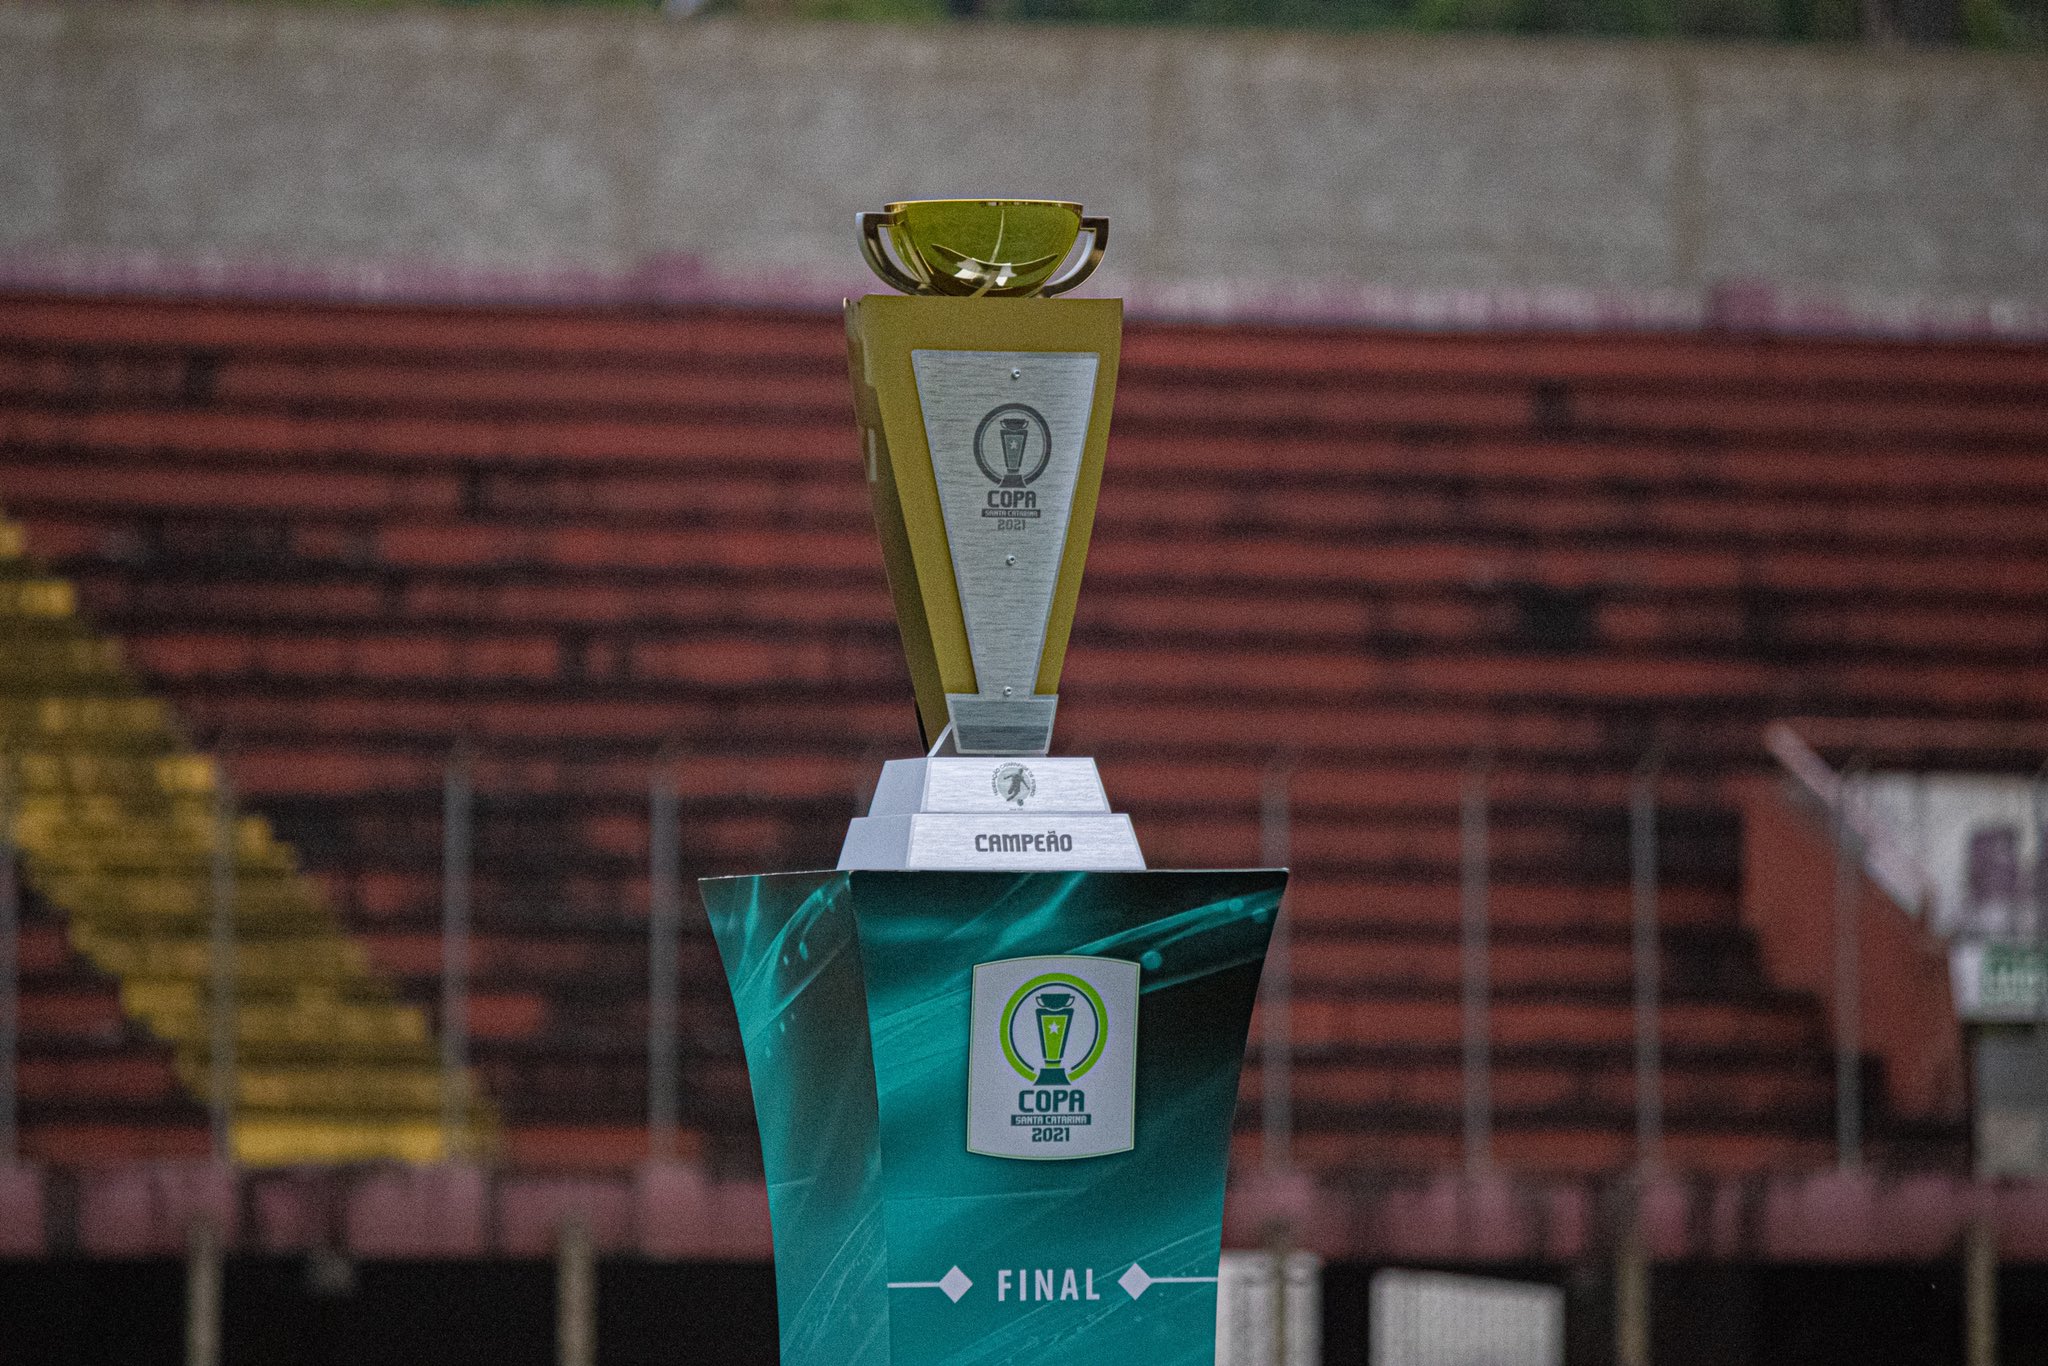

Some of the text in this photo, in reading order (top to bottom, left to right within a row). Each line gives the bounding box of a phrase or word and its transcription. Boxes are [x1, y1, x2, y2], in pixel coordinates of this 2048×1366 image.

[987, 490, 1036, 508] COPA
[997, 518, 1026, 530] 2021
[975, 830, 1073, 853] CAMPEÃO
[1018, 1089, 1085, 1113] COPA
[1015, 1115, 1087, 1125] SANTA CATARINA
[1031, 1127, 1070, 1142] 2021
[997, 1268, 1100, 1302] FINAL
